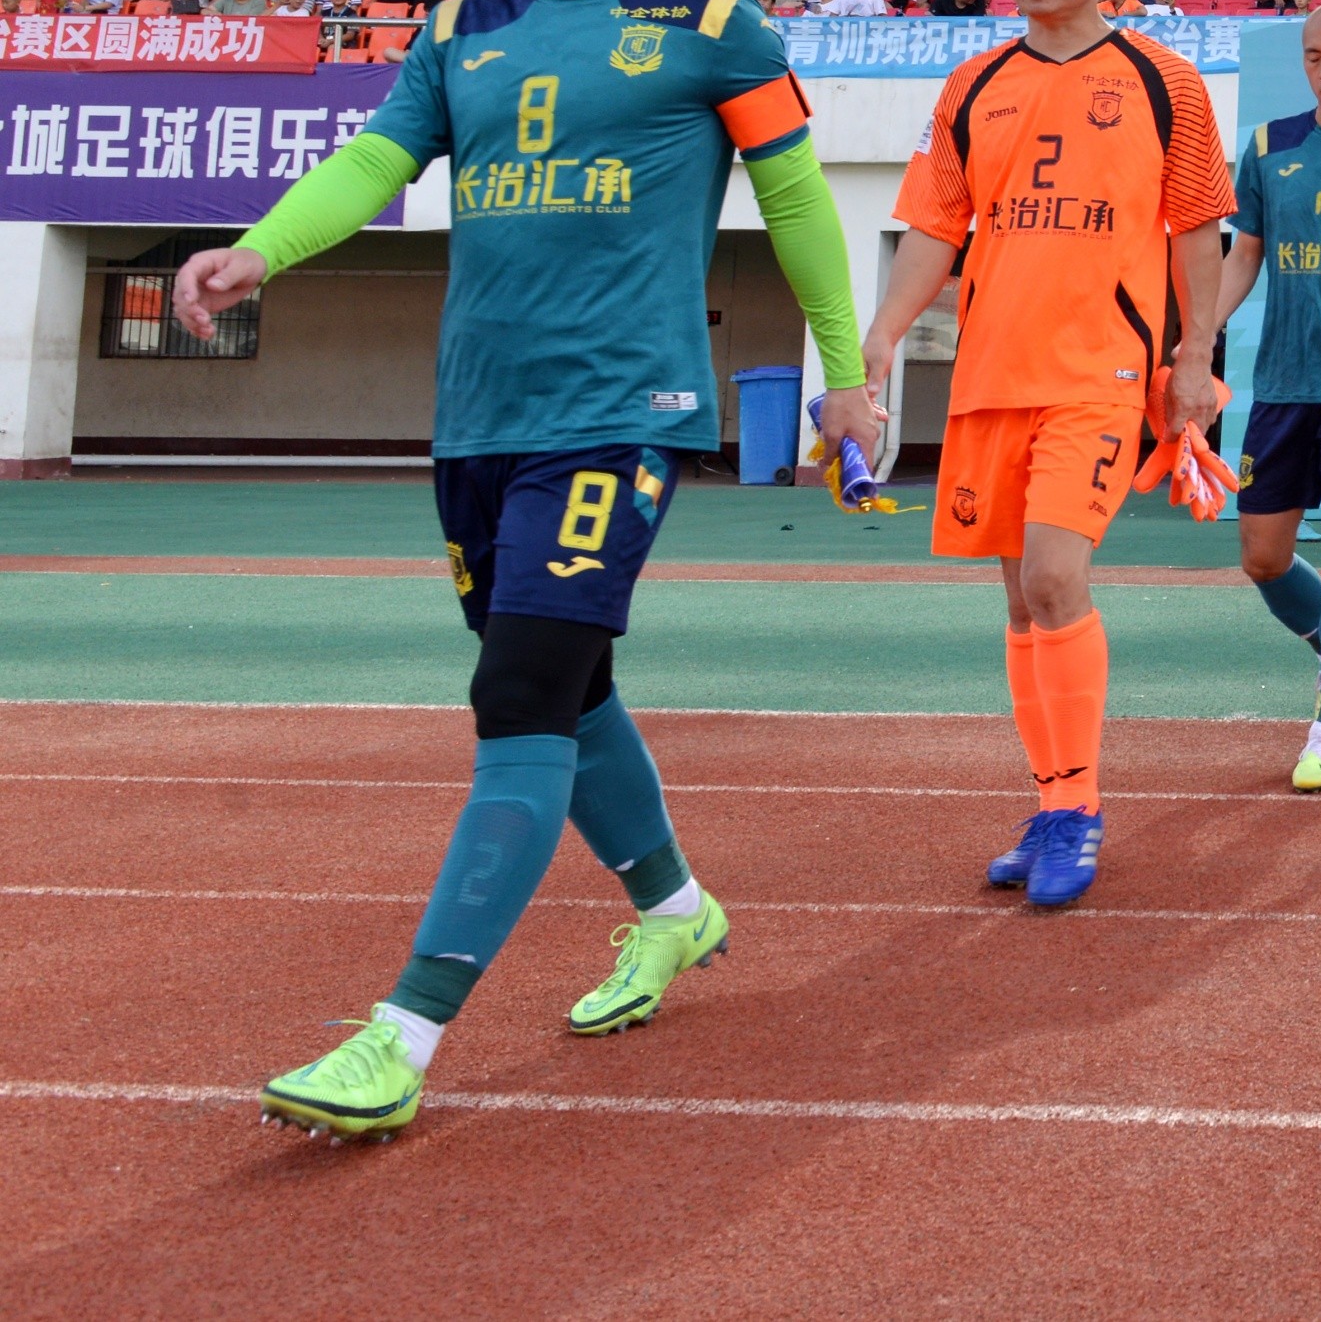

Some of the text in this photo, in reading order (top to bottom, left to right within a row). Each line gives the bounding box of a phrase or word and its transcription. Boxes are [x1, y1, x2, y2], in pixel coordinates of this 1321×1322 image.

[516, 75, 560, 154] 8
[456, 158, 632, 213] 长治汇承
[1032, 134, 1063, 190] 2
[540, 205, 593, 214] SPORTS
[596, 205, 631, 214] CLUB
[988, 197, 1114, 234] 长治汇承
[1092, 433, 1122, 492] 2
[558, 471, 618, 551] 8
